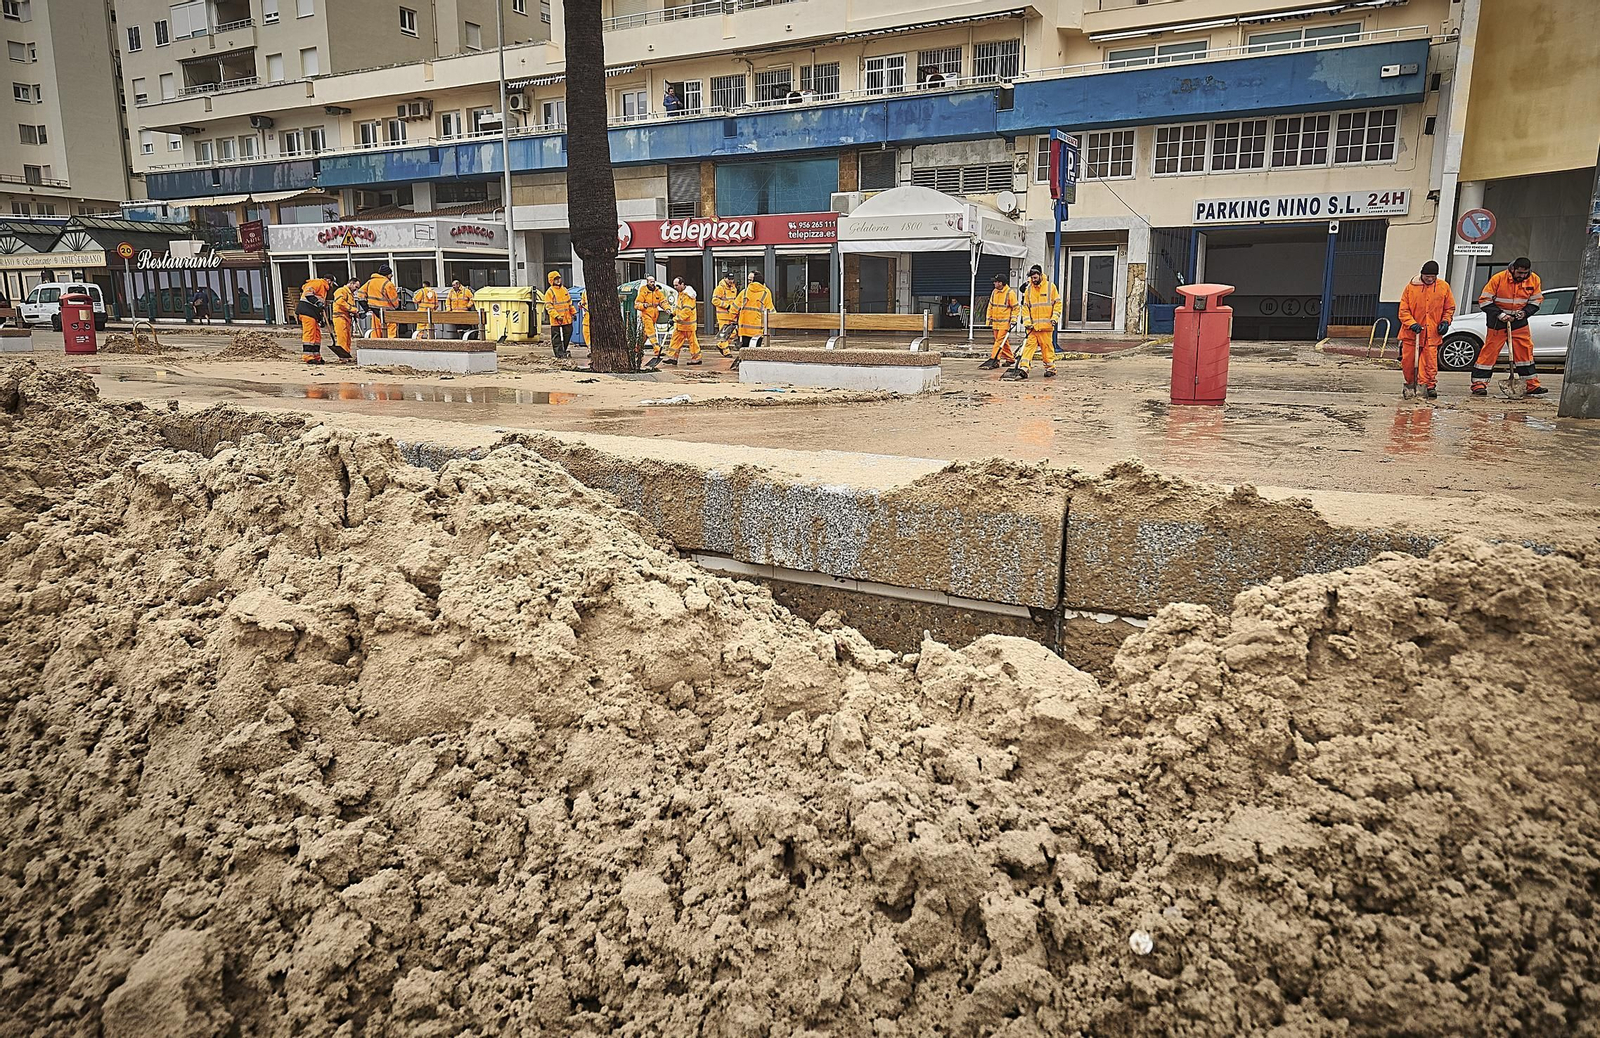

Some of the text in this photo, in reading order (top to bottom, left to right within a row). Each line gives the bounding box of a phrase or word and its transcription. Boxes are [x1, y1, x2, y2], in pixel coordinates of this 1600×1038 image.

[1367, 191, 1405, 207] 24H
[1196, 195, 1361, 220] PARKING NINO S.L.
[799, 221, 811, 229] 956
[824, 220, 836, 228] 111
[849, 221, 923, 235] Gelateria 1800
[450, 225, 495, 240] CAPRICCIO
[659, 219, 754, 248] telepizza
[788, 230, 836, 240] telepizza.es
[137, 248, 222, 270] Restaurante
